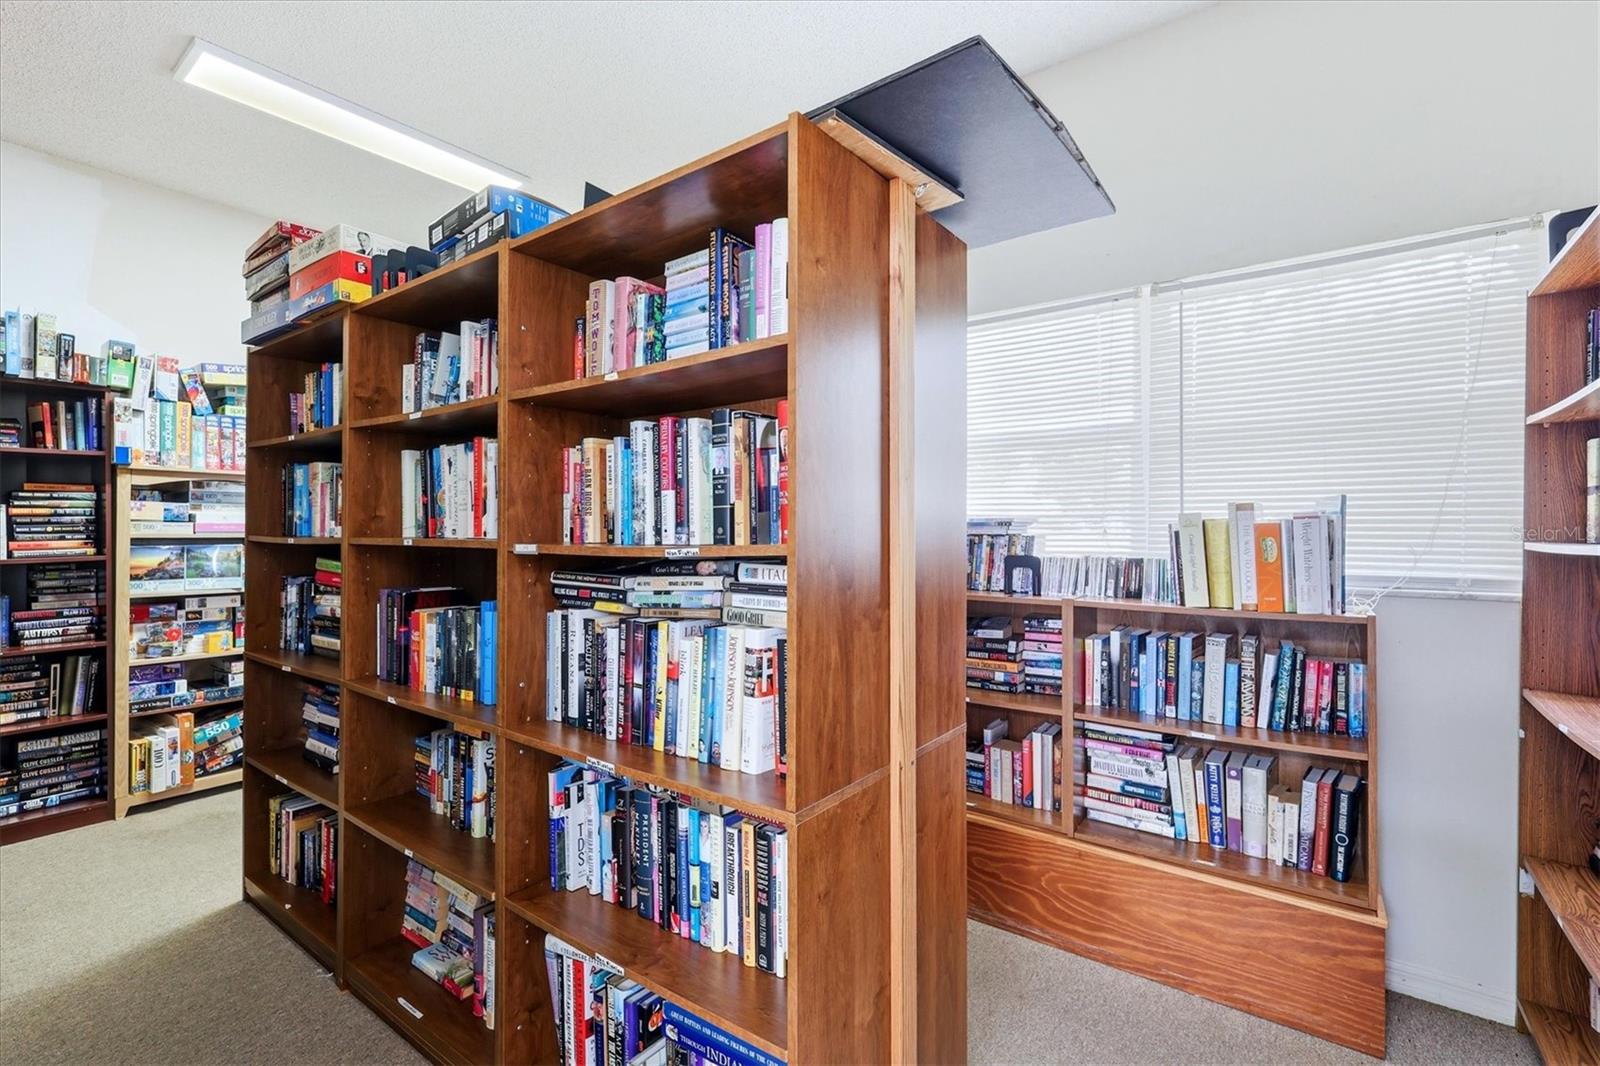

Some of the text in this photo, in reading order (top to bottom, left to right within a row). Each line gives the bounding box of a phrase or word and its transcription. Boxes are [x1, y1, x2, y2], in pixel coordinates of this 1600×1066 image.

[722, 246, 730, 280] STUART
[721, 282, 729, 317] WOODS
[148, 414, 158, 449] springbok
[660, 420, 668, 455] PRIMARY
[1242, 524, 1252, 593] THE WAY TO COOK
[1301, 522, 1313, 583] Weight Watchers
[727, 608, 744, 623] GOOD
[24, 629, 63, 638] AUTOPSY
[679, 650, 687, 676] blink
[727, 635, 738, 712] JOHNSON JOHNSON
[1241, 663, 1255, 716] THE ASSASSINS
[205, 721, 230, 737] 550
[40, 756, 63, 764] CUSSLER
[39, 766, 65, 774] CUSSLER
[40, 775, 66, 784] CUSSLER
[1117, 764, 1143, 777] KELLERMAN
[1209, 766, 1218, 782] KITTY
[1211, 784, 1219, 804] KELLEY
[1339, 794, 1348, 815] RAYMOND
[671, 1011, 684, 1021] GREAT
[616, 1035, 621, 1053] MY
[680, 1034, 706, 1053] THROUGH
